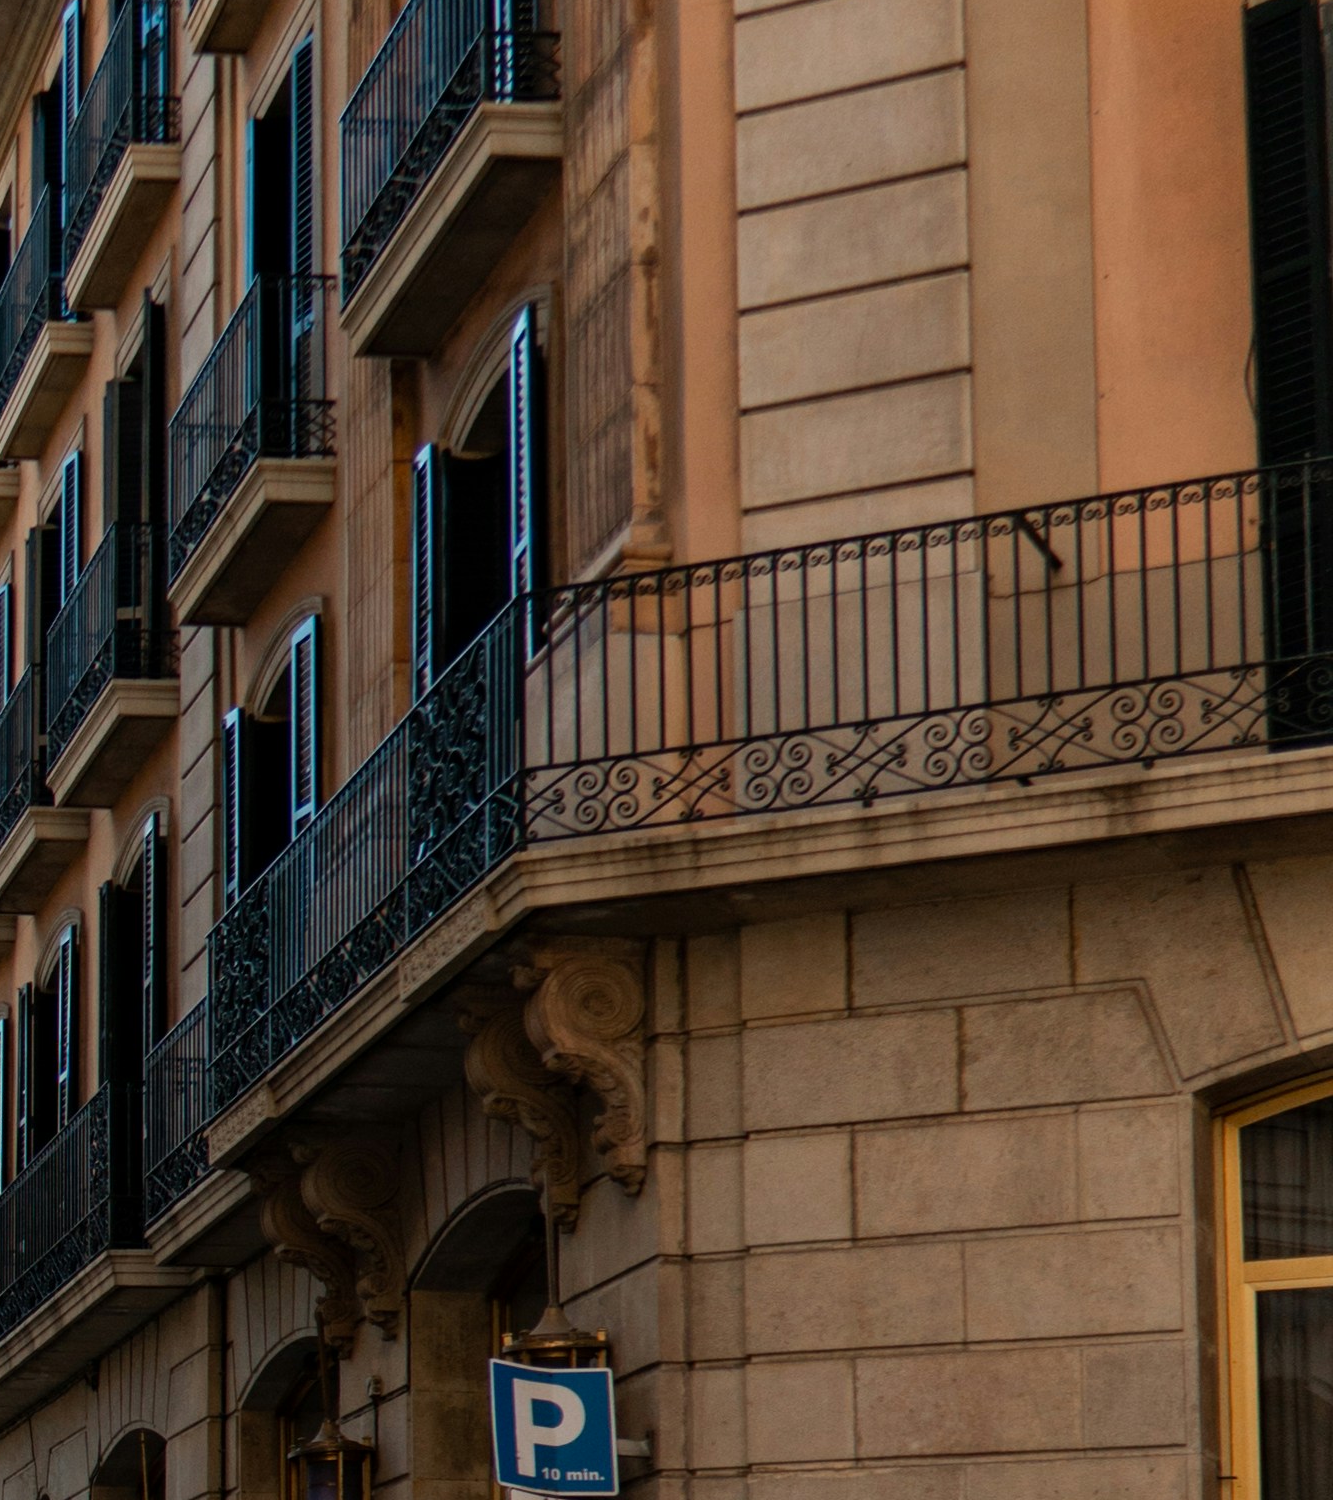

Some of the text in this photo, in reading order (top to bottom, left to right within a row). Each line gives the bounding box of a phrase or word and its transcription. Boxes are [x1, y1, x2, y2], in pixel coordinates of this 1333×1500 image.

[512, 1377, 586, 1478] P
[541, 1467, 605, 1481] 10 min.
